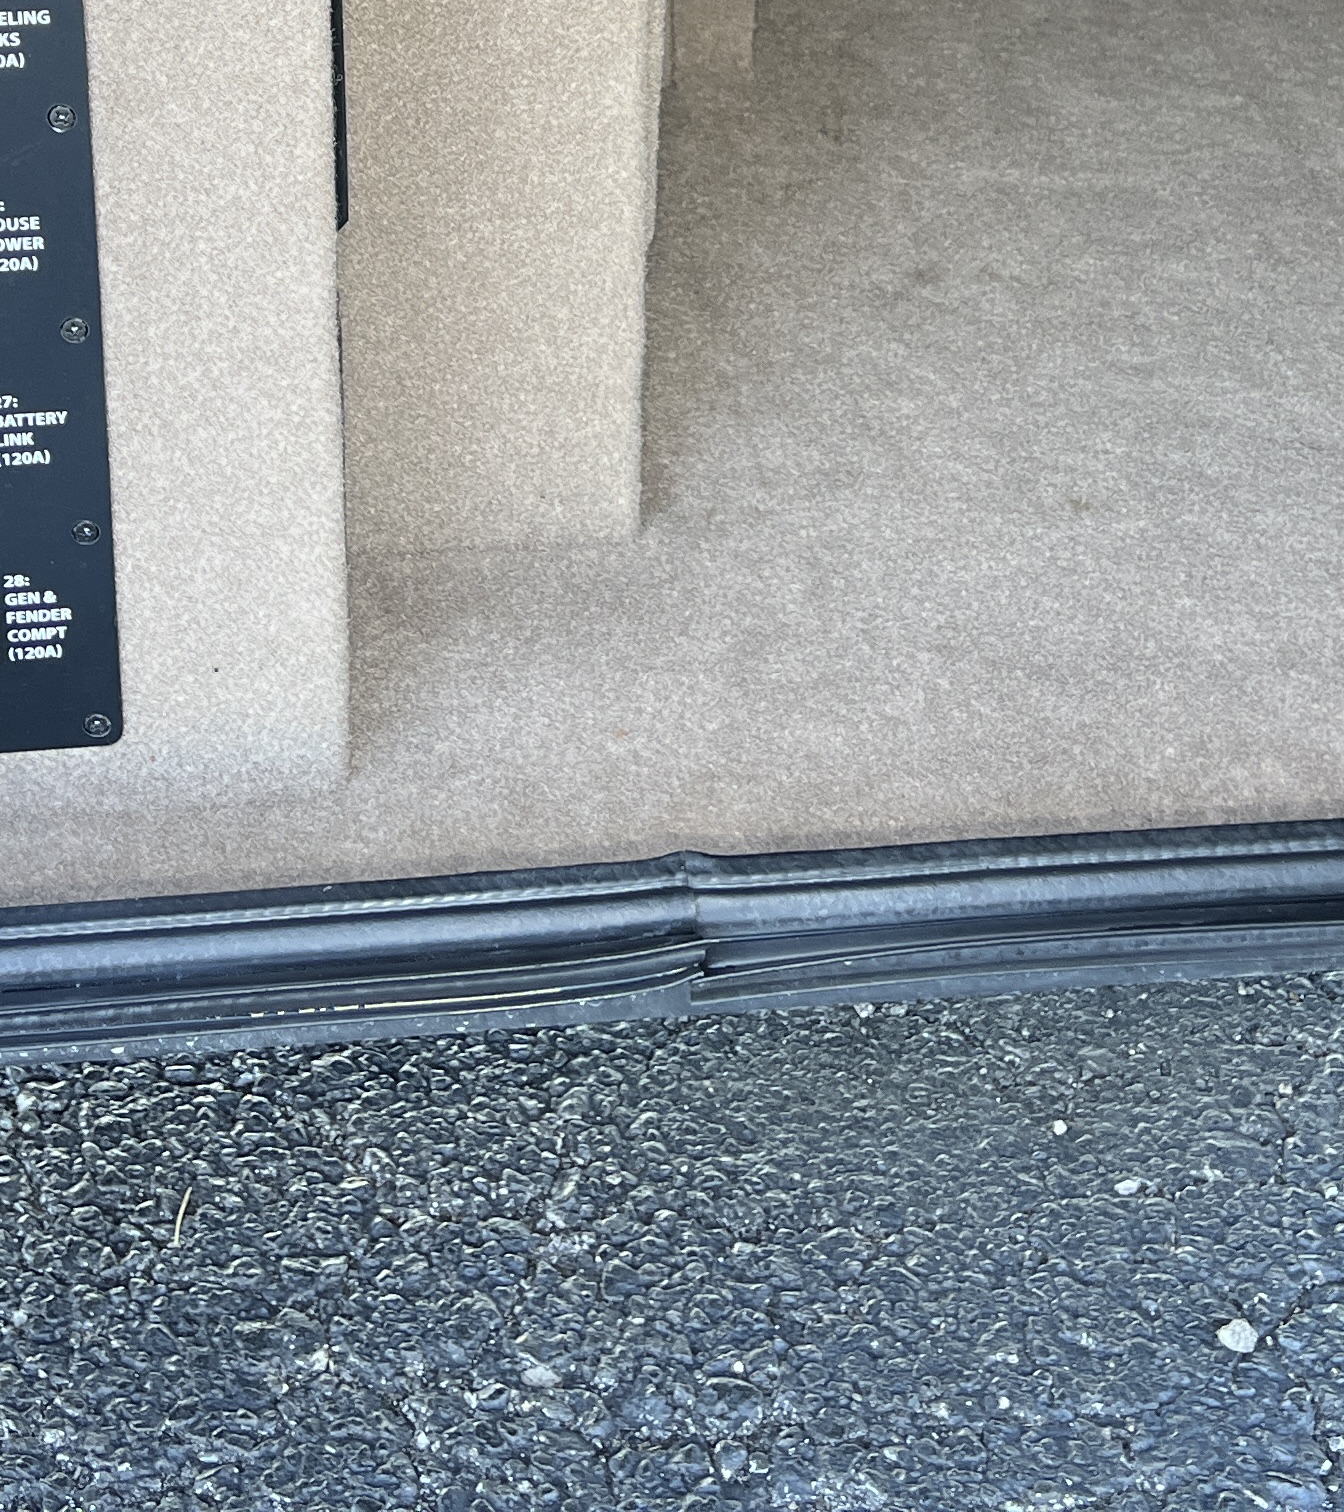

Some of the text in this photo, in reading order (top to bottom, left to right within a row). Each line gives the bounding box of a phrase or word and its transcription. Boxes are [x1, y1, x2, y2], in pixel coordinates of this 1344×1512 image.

[3, 575, 30, 588] 28:
[5, 591, 58, 606] GEN &
[6, 608, 73, 625] FENDER
[7, 626, 68, 643] COMPT
[8, 644, 63, 662] (120A)
